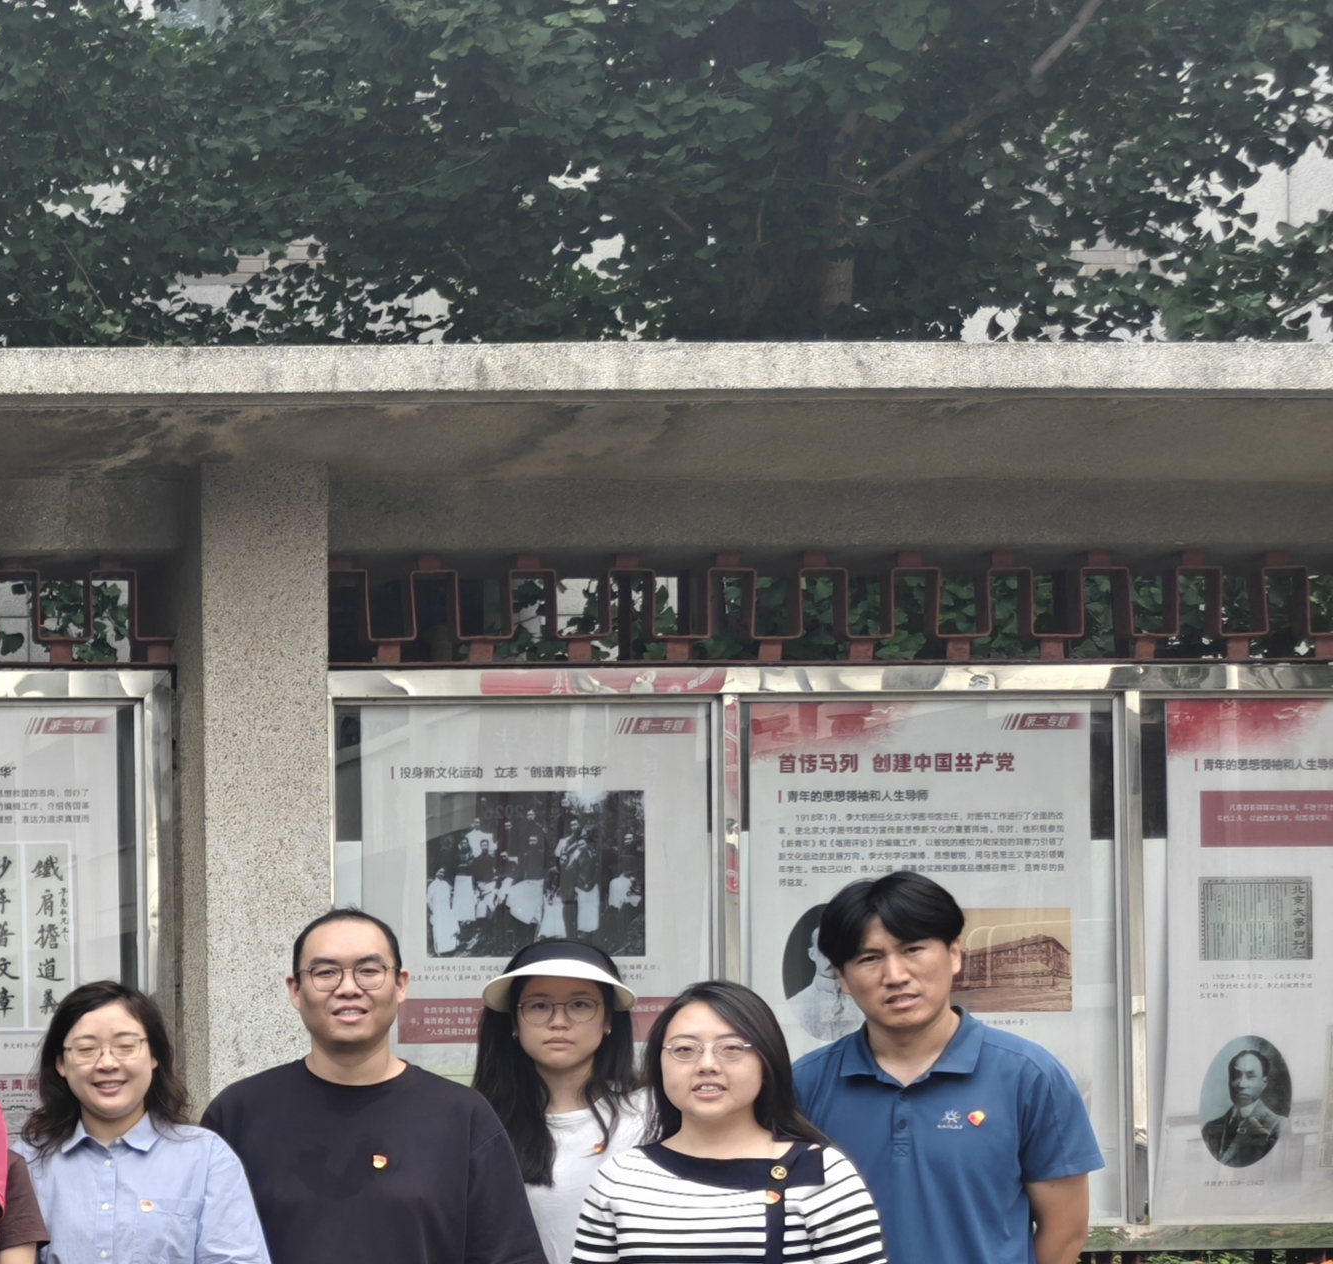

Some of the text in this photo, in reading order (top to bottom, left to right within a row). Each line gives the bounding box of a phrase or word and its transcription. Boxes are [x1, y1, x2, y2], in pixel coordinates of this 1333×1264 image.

[47, 719, 96, 733] 第一专题
[638, 719, 685, 733] 第一专题
[1022, 715, 1071, 728] 第二专题
[872, 752, 1015, 773] 创建中国共产党
[399, 766, 483, 779] 投身新文化运动
[787, 789, 929, 803] 青年的思想领袖和人生导师
